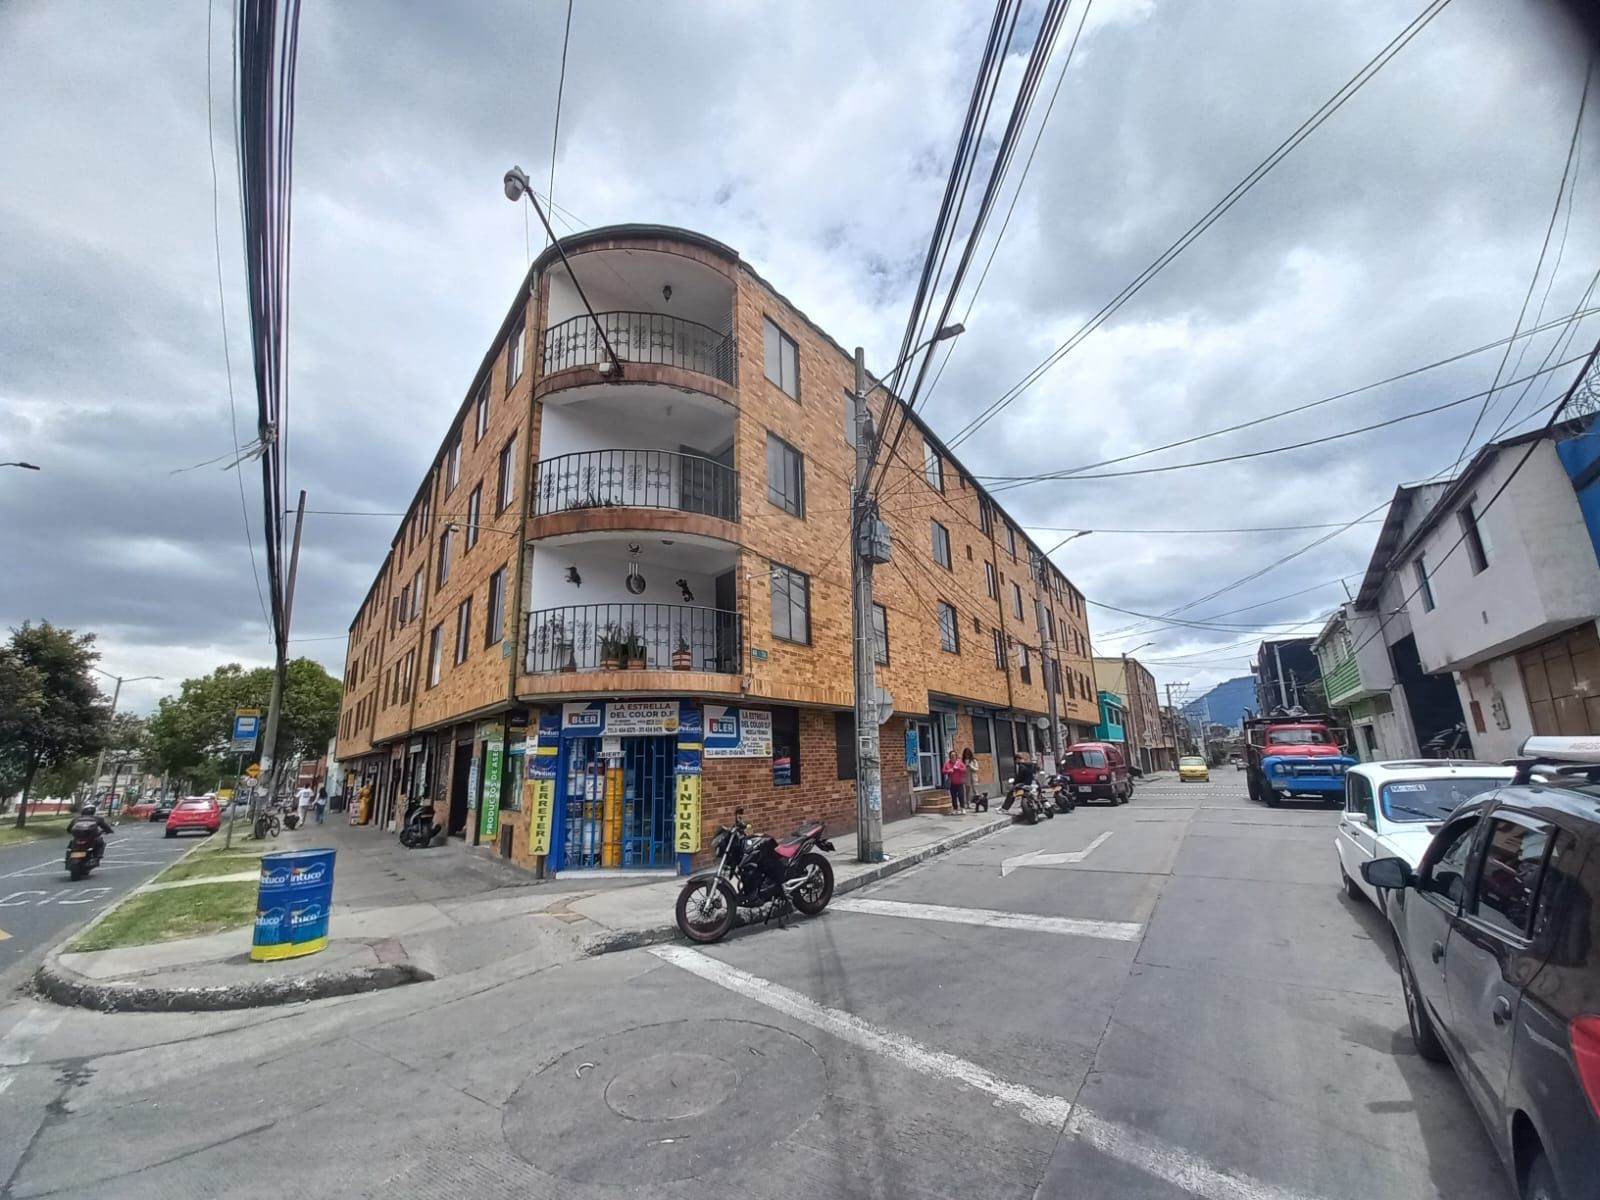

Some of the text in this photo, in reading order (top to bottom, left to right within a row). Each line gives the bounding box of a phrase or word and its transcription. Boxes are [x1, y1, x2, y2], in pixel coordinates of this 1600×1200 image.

[614, 703, 671, 711] LA ESTRELLA
[572, 715, 597, 724] BLER
[610, 711, 627, 719] DEL
[713, 722, 734, 732] BLER
[486, 744, 500, 834] PRODUCTOS DE ASEO
[680, 775, 692, 850] PINTURAS
